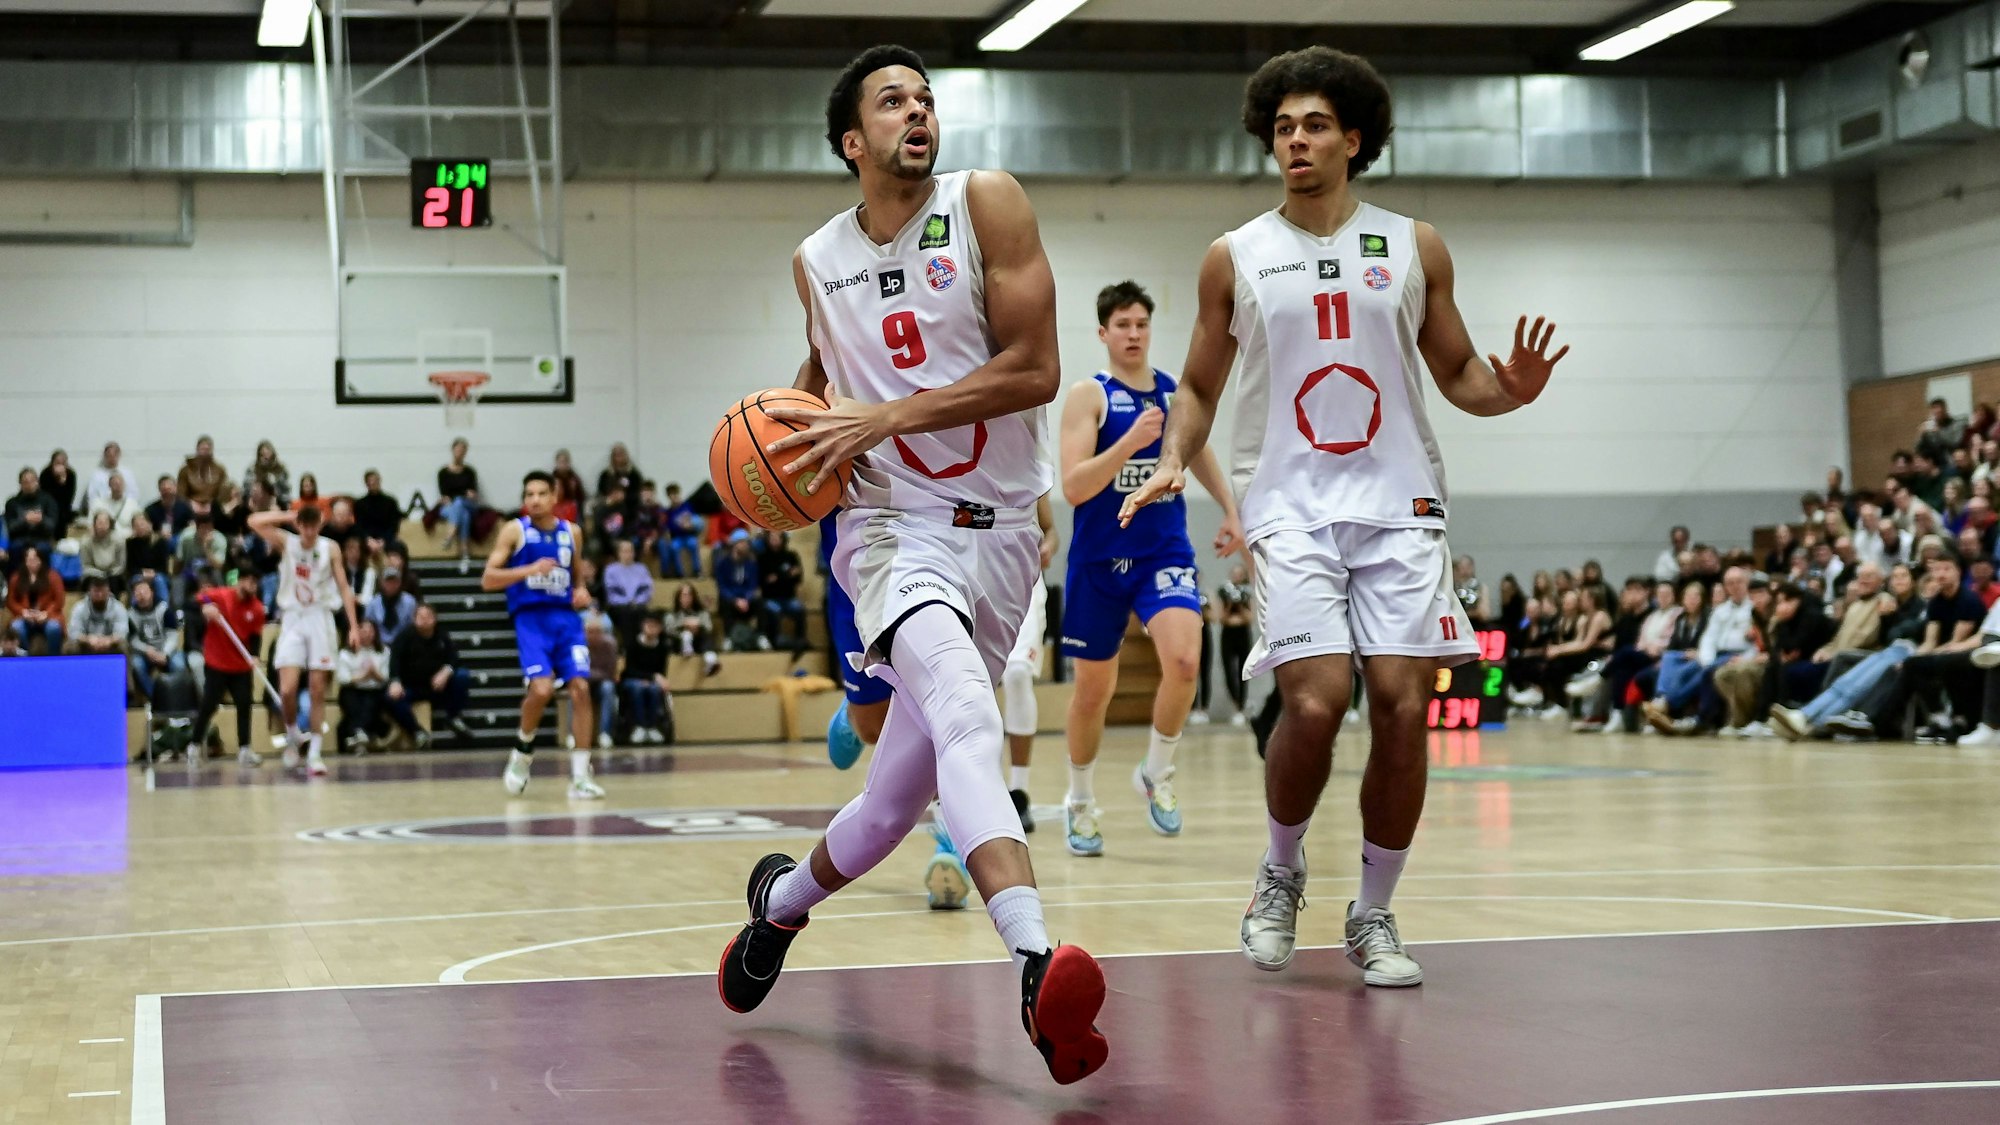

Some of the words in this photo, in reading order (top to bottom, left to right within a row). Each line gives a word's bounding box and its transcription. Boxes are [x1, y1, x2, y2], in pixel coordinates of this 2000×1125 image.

[437, 163, 487, 190] 1:34
[423, 187, 474, 228] 21
[824, 268, 869, 295] SPALDING
[935, 272, 956, 285] STARS
[1258, 261, 1307, 280] SPALDING
[1313, 291, 1351, 340] 11
[881, 311, 928, 370] 9
[899, 581, 950, 598] SPALDING
[1439, 616, 1458, 640] 11
[1269, 632, 1312, 653] SPALDING
[1483, 666, 1503, 697] 2
